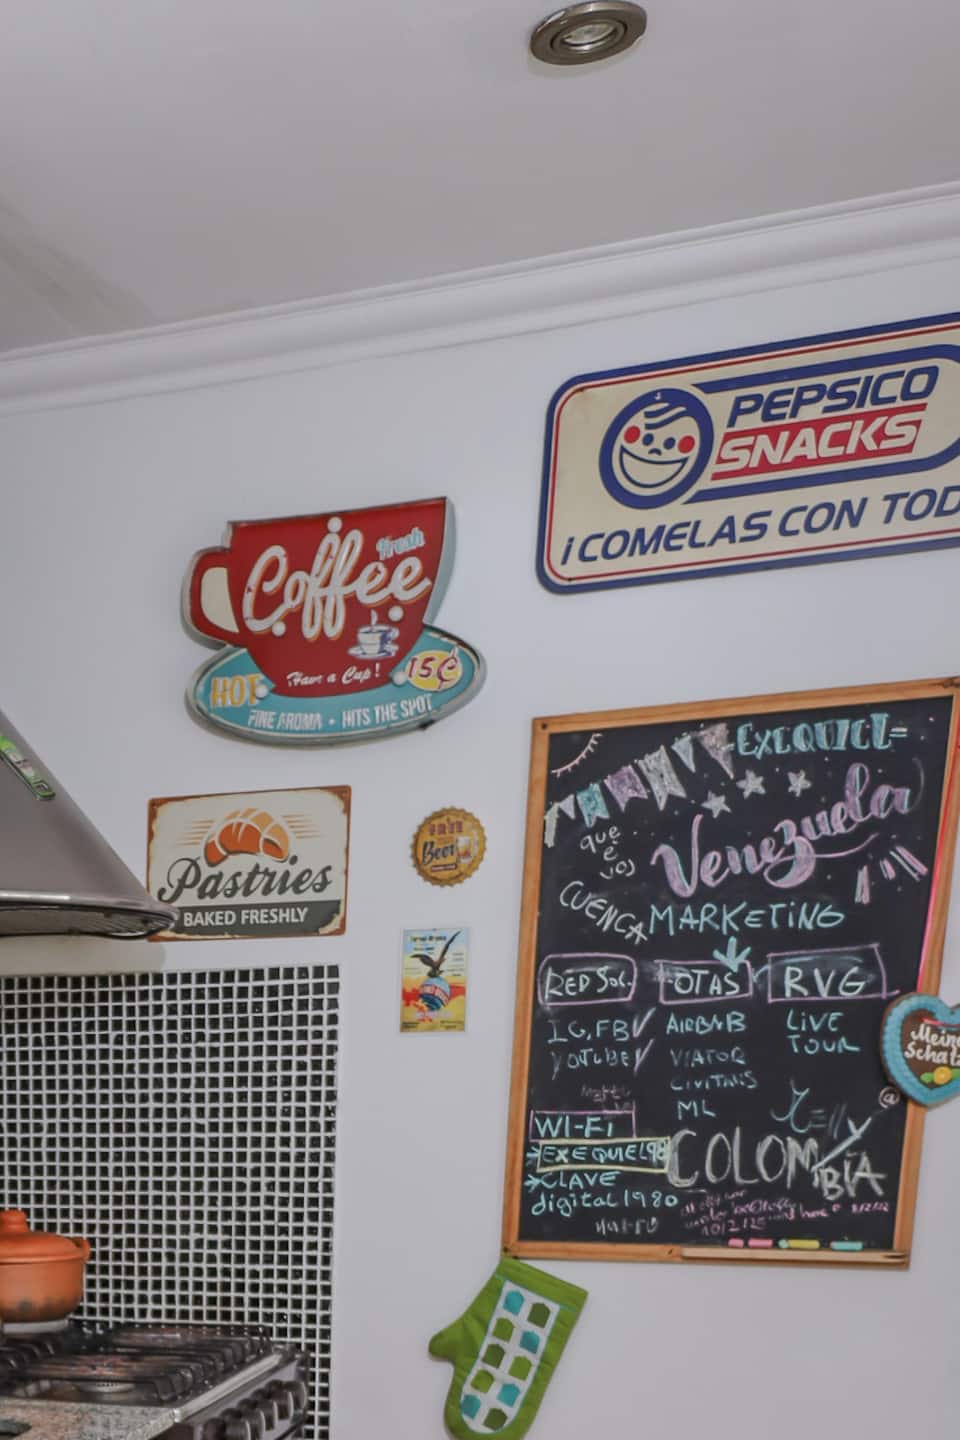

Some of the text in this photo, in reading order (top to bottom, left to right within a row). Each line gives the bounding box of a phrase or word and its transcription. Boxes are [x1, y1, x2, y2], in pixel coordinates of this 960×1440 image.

[727, 365, 939, 428] PEPSICO
[719, 413, 921, 469] SNACKS
[778, 498, 869, 537] CON
[243, 529, 432, 641] Coffee
[210, 674, 263, 708] HOT
[327, 674, 337, 683] a
[248, 694, 433, 731] FINE AROMA HITS THE SPOT
[650, 763, 910, 898] Venezuela
[157, 855, 332, 903] Pastries
[183, 907, 308, 927] BAKED FRESHLY
[560, 880, 648, 945] CUENCA
[784, 966, 865, 998] RVG
[904, 1041, 960, 1067] Schat
